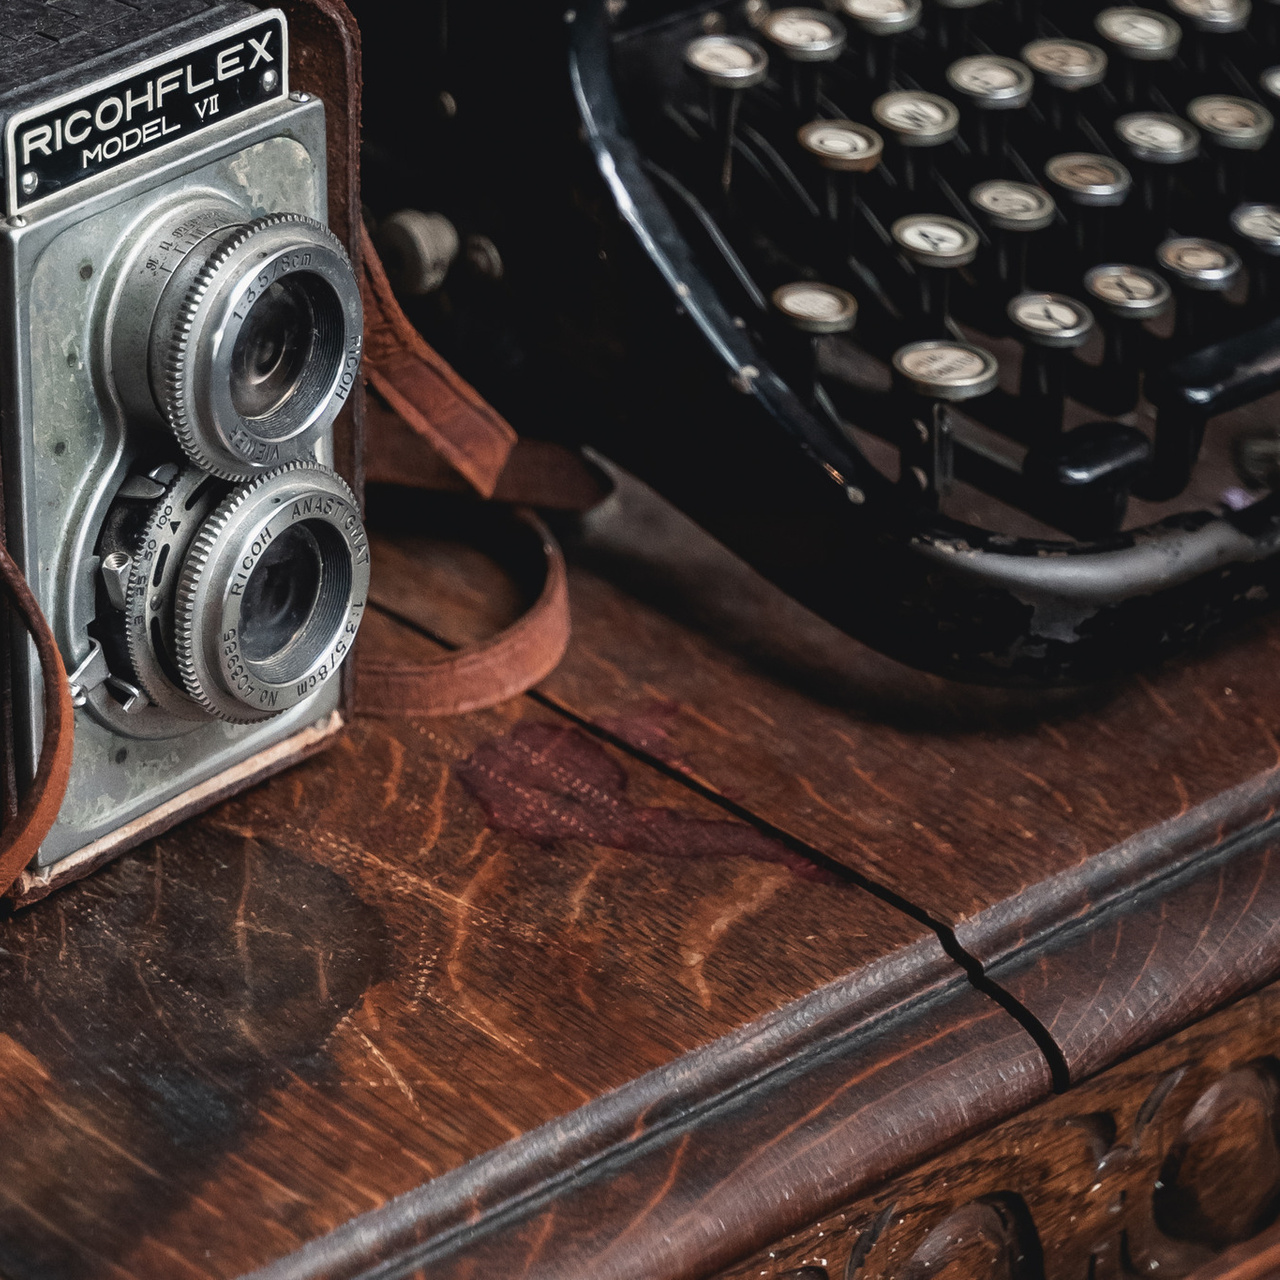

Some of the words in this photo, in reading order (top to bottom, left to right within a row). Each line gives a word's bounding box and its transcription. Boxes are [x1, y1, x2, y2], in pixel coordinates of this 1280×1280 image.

[23, 30, 274, 166] RICOHFLEX
[82, 116, 181, 168] MODEL
[193, 92, 220, 120] VII
[335, 335, 362, 401] RICOH
[230, 527, 273, 597] RICOH
[291, 496, 370, 568] ANASTIGMAT
